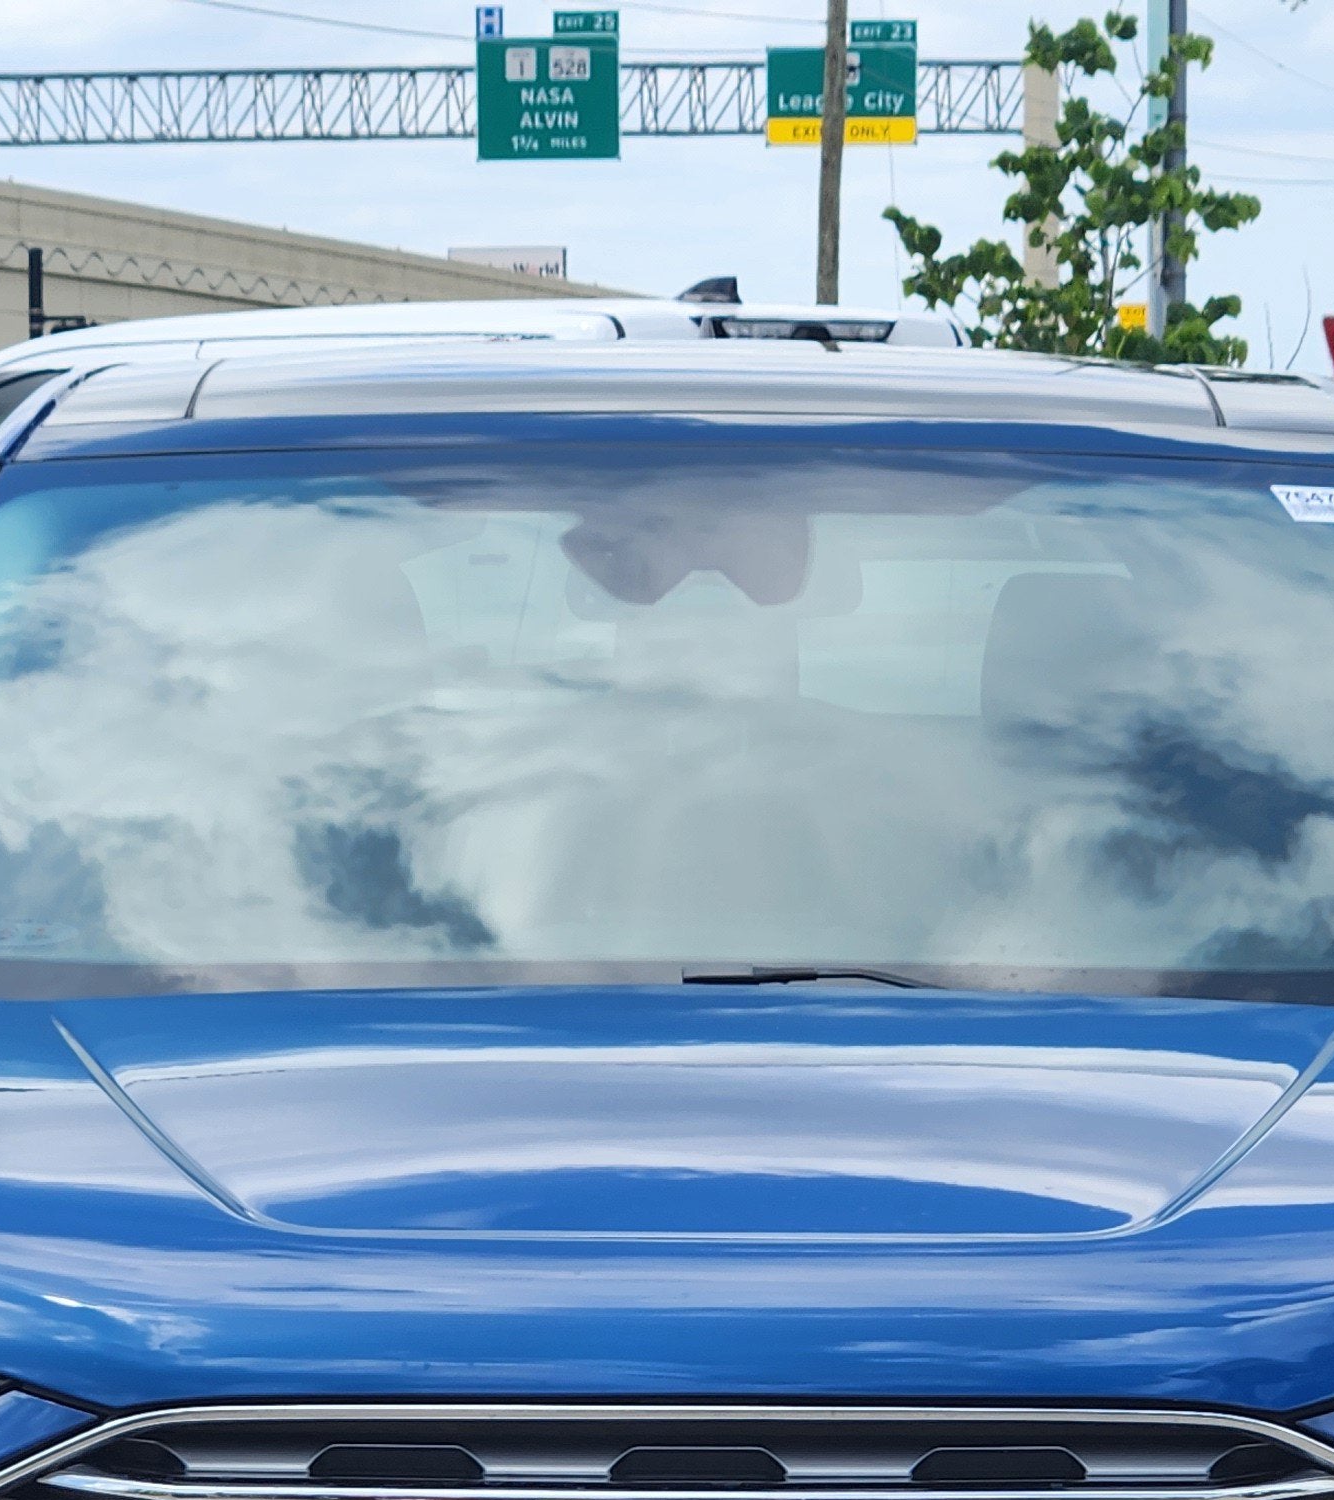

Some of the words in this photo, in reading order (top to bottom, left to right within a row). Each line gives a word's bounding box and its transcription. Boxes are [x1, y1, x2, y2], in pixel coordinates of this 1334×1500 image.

[558, 15, 584, 29] EXIT
[855, 25, 881, 38] EXIT
[520, 86, 574, 105] NASA
[864, 90, 904, 114] City
[519, 111, 578, 129] ALVIN
[792, 125, 823, 138] EXI
[850, 125, 891, 137] ONLY
[550, 136, 587, 149] MILES
